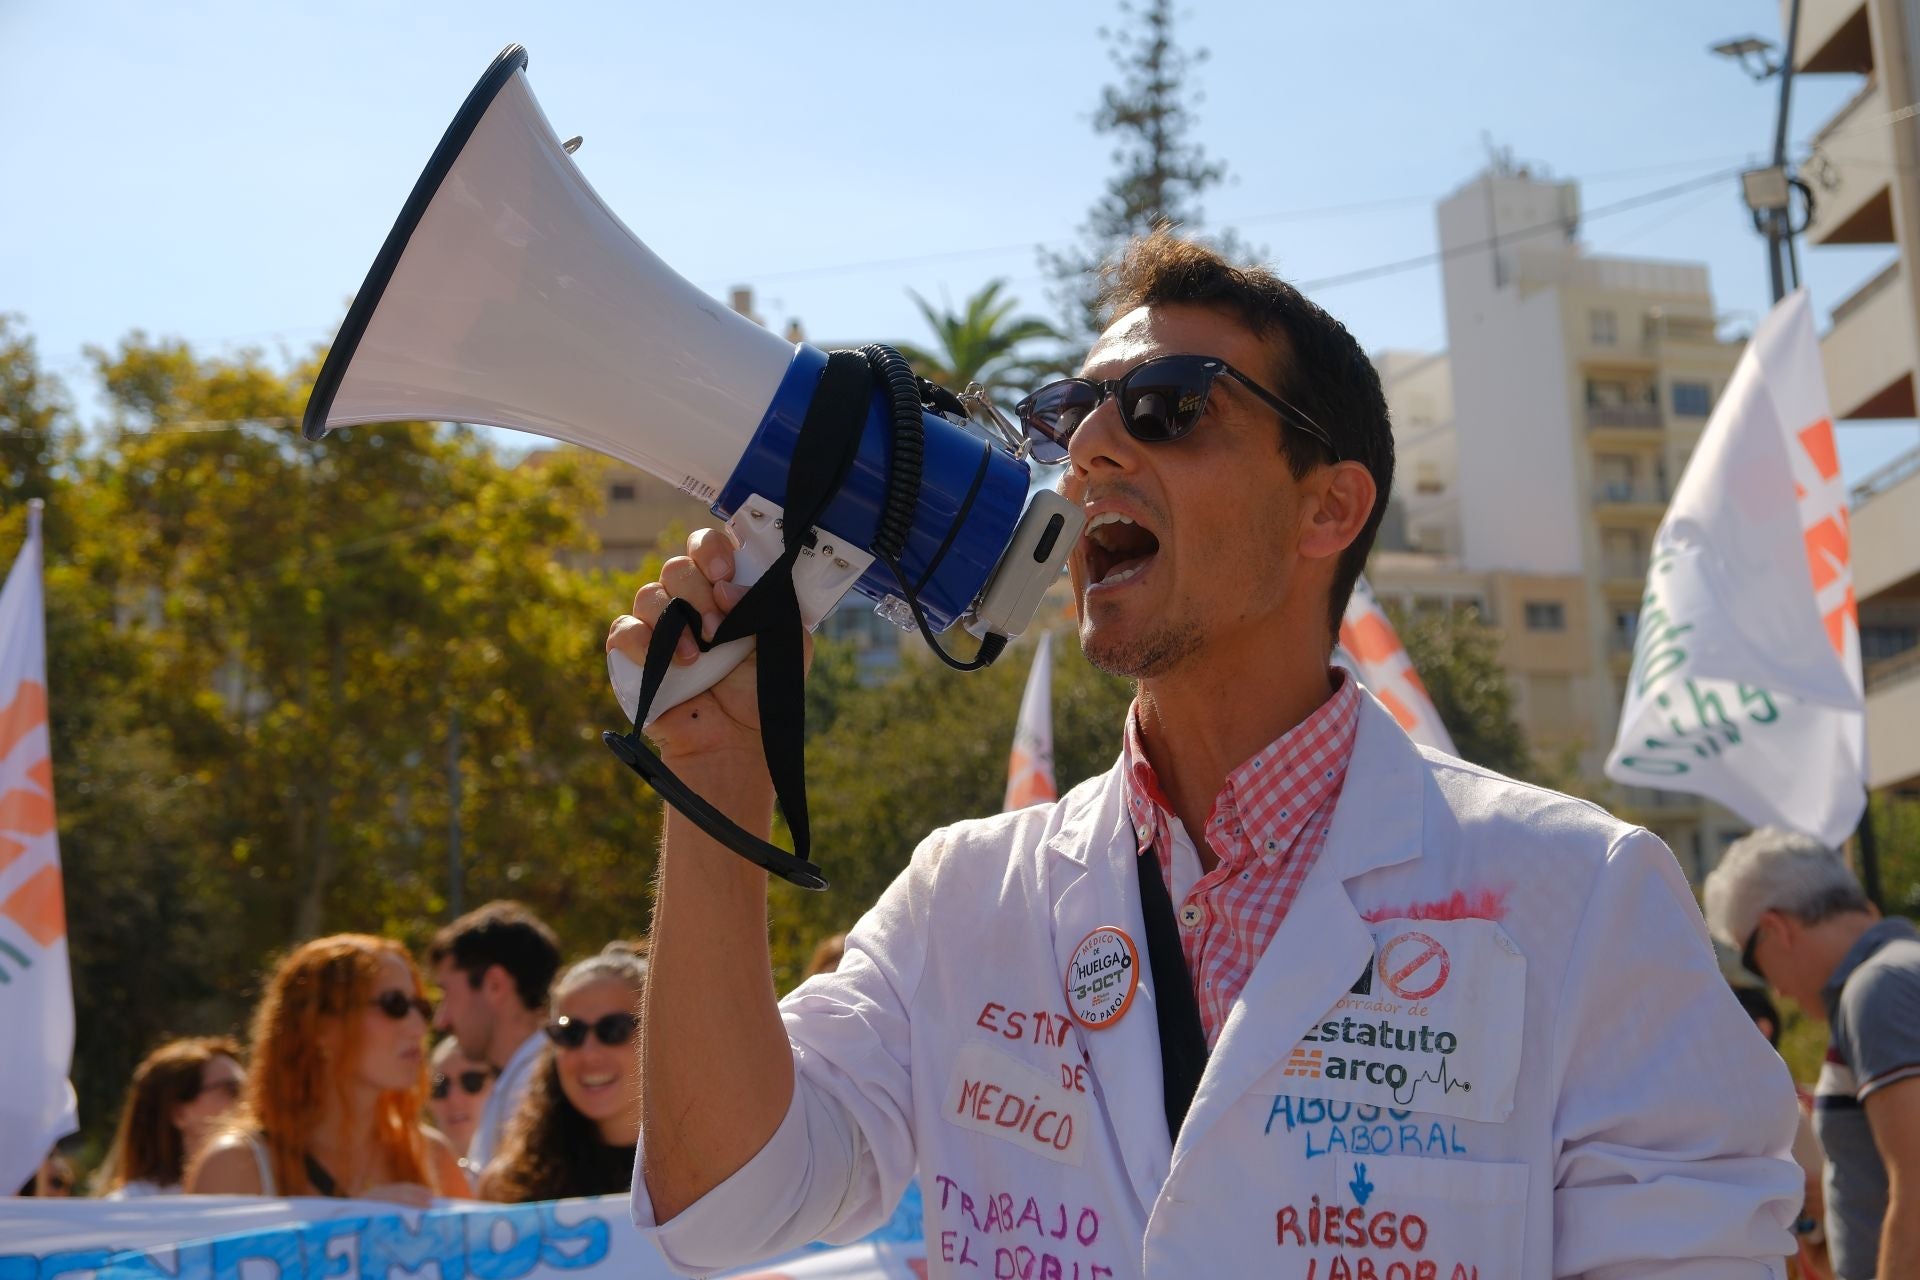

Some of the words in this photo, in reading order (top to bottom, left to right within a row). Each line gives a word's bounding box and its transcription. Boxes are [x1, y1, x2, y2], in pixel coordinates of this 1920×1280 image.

[802, 548, 816, 559] OFF
[1079, 952, 1121, 980] HUELGA
[1093, 947, 1100, 956] DE
[1076, 969, 1124, 1001] 3-OCT
[1100, 992, 1125, 1021] PARO!
[1336, 996, 1401, 1016] orrador
[1408, 1000, 1429, 1017] de
[1061, 1063, 1090, 1093] DE
[1305, 1122, 1468, 1160] LABORAL
[936, 1174, 1099, 1246] TRABAJO
[0, 1203, 611, 1280] NDEMOS
[941, 1231, 978, 1267] EL
